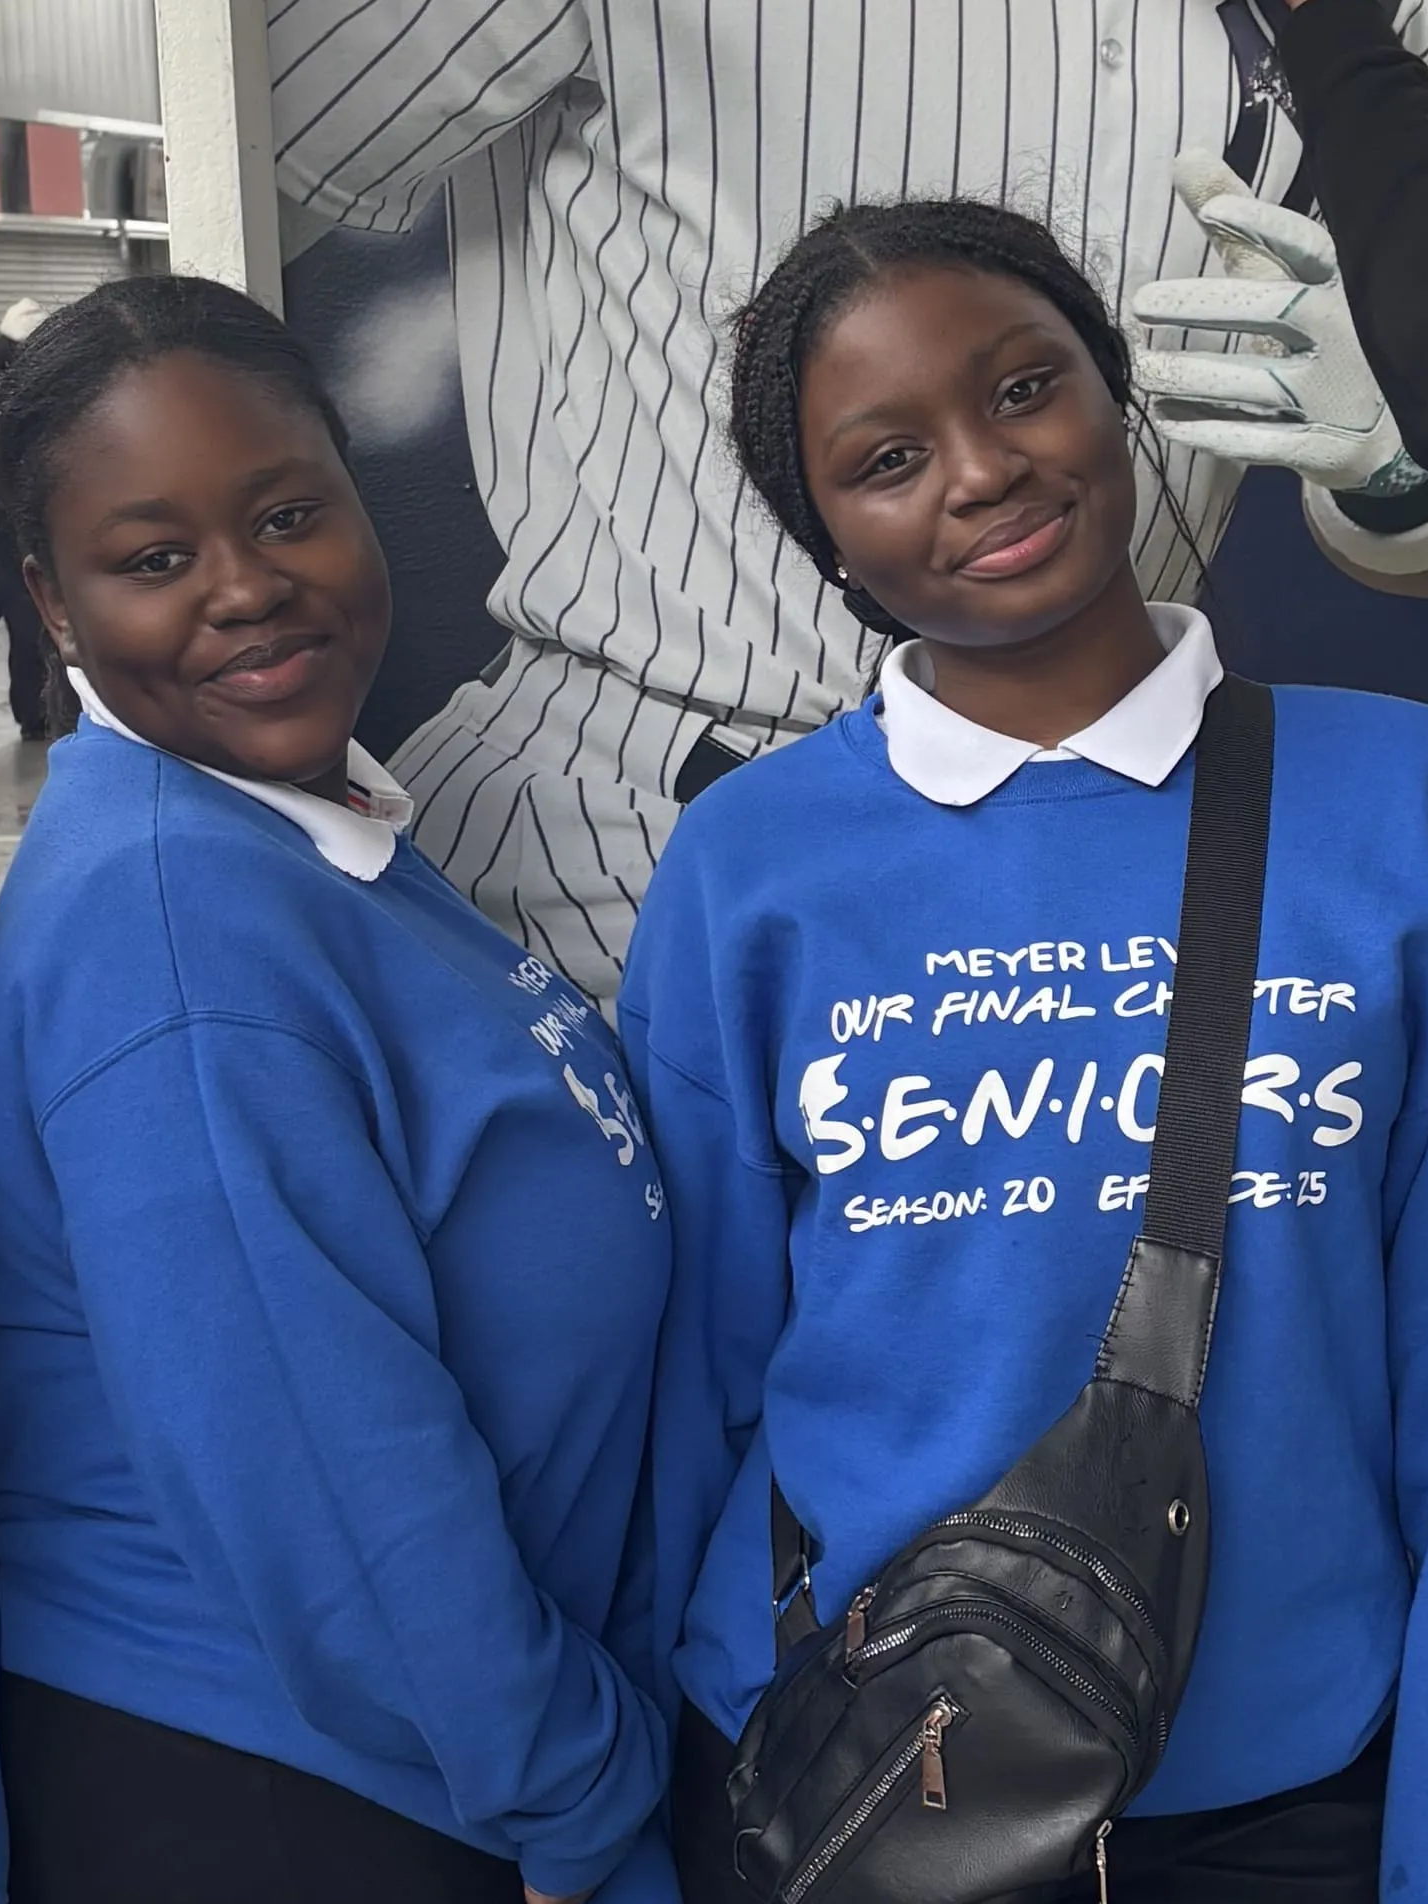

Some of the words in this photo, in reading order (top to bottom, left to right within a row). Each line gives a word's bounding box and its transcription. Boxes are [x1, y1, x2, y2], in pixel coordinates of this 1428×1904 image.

[925, 941, 1086, 978] MEYER
[830, 993, 915, 1045] OUR
[931, 983, 1097, 1037] FINAL
[1113, 976, 1356, 1023] CHTER
[843, 1187, 987, 1233] SEASON:
[1002, 1176, 1056, 1218] 20
[1296, 1171, 1328, 1207] 25
